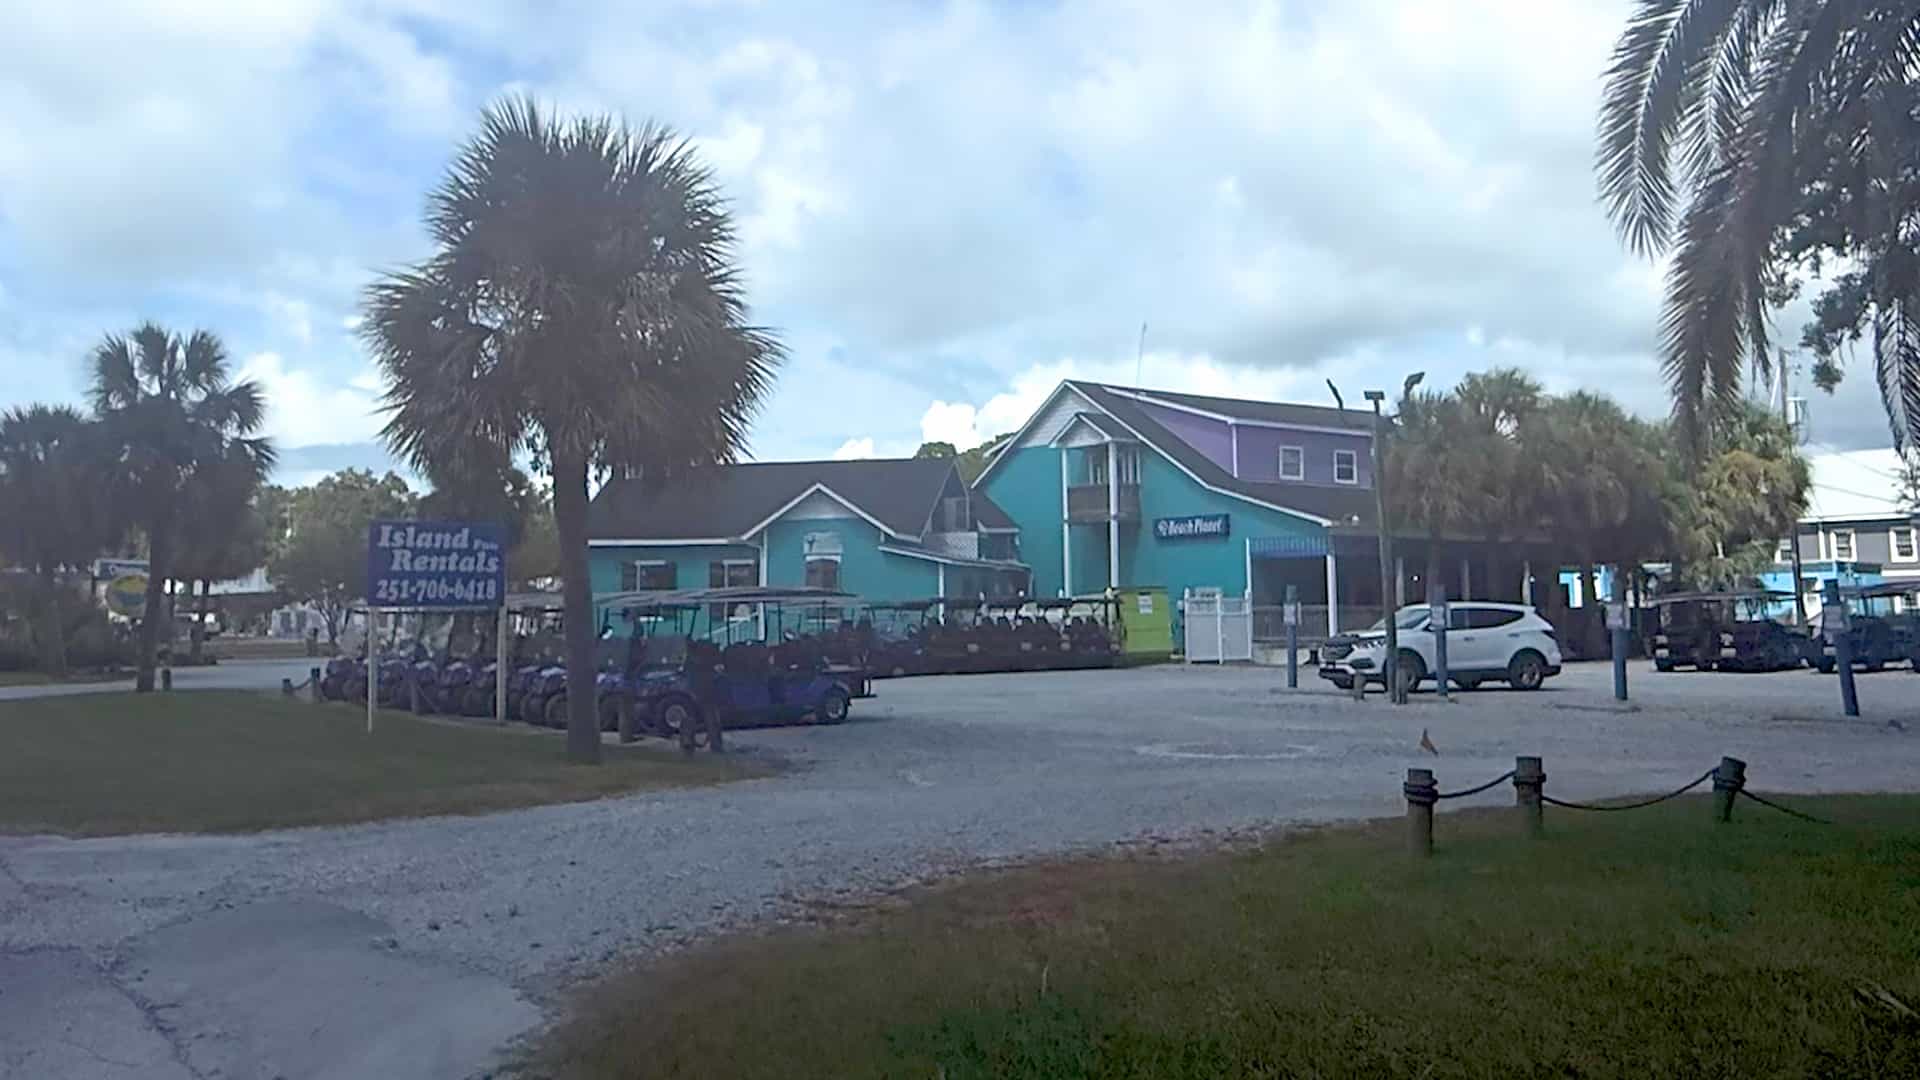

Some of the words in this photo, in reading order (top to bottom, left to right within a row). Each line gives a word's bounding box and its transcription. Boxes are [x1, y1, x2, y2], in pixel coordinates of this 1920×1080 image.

[377, 525, 469, 549] Island
[1168, 520, 1193, 535] Beach
[390, 549, 499, 573] Rentals
[375, 579, 497, 602] 251-706-6418
